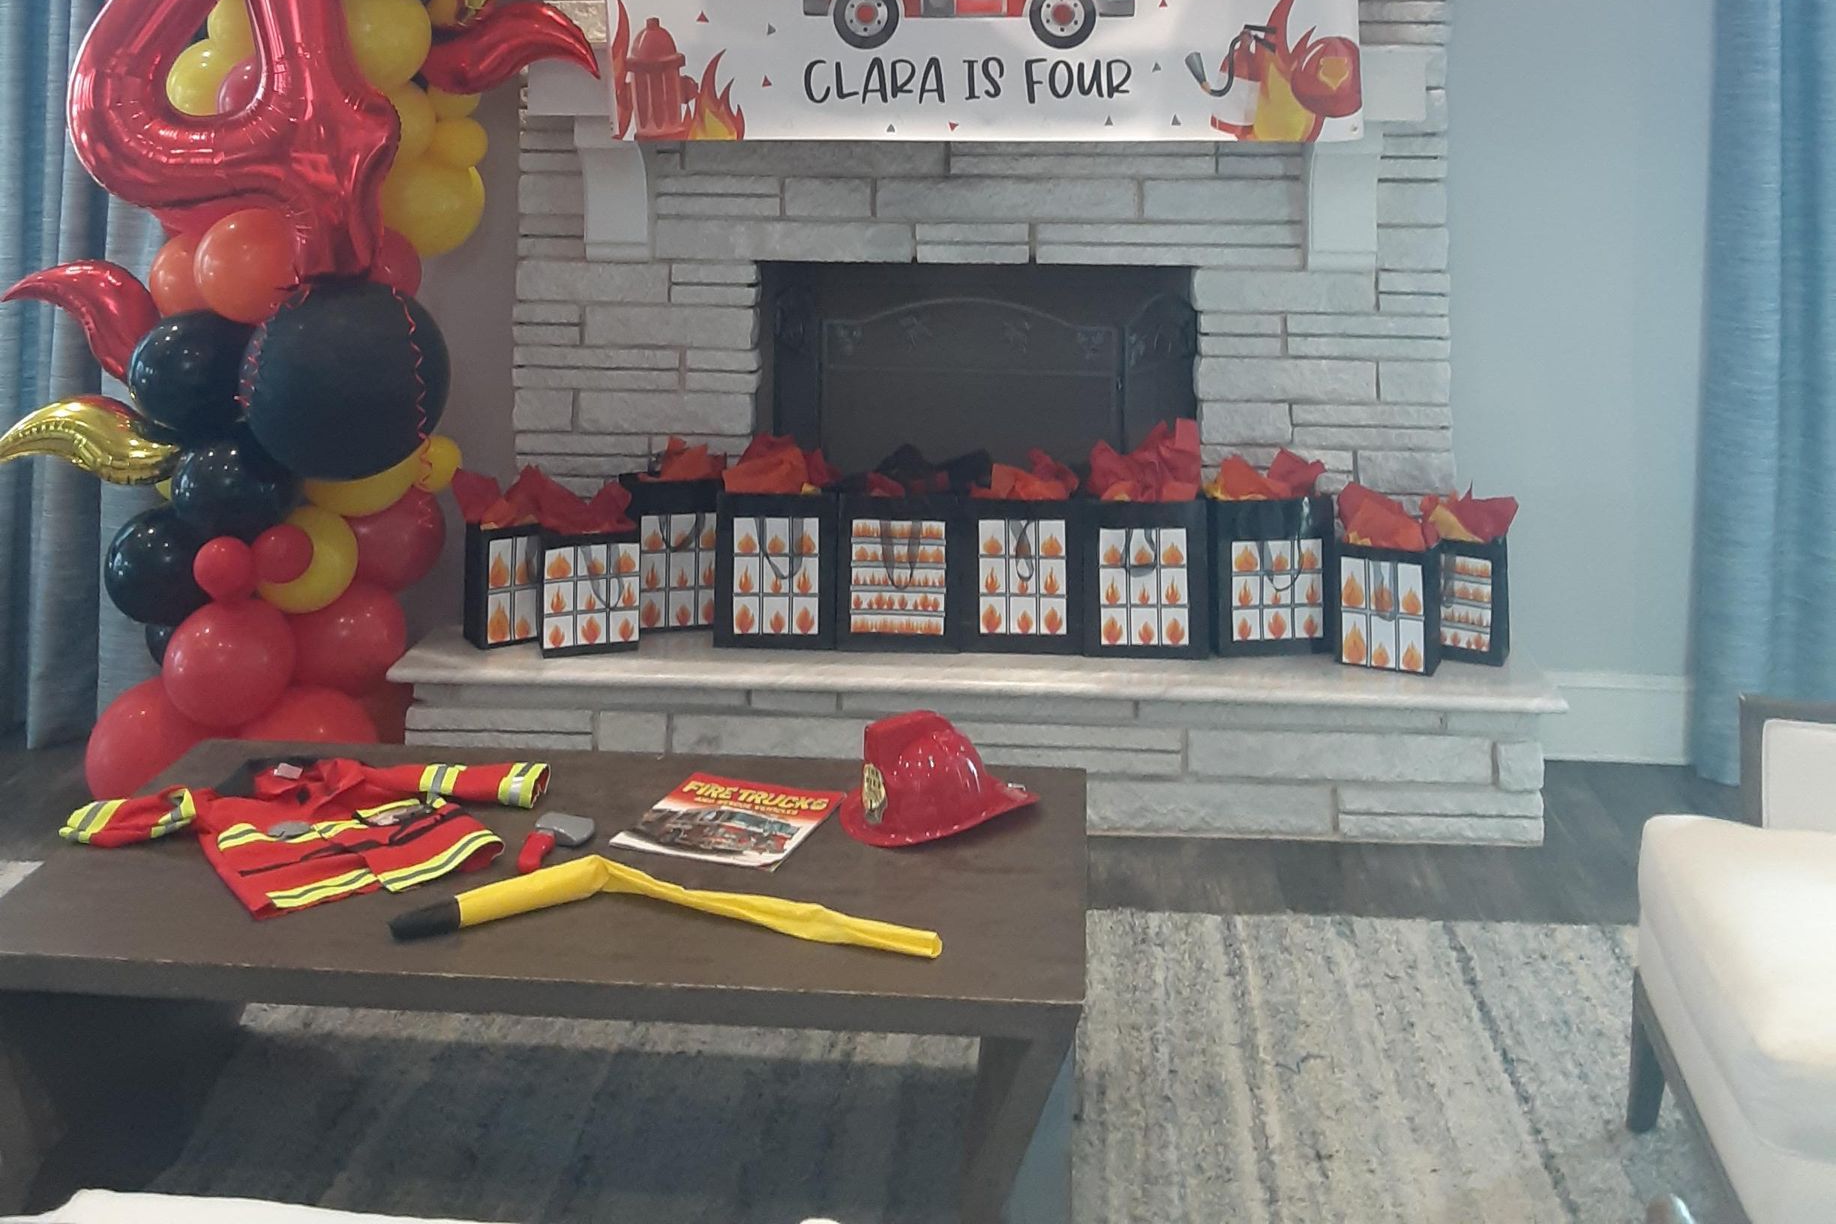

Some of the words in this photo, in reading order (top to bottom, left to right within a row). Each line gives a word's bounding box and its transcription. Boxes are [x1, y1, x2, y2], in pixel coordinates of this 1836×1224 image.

[803, 56, 946, 104] CLARA
[962, 56, 1005, 101] IS
[1024, 57, 1133, 104] FOUR
[683, 780, 738, 799] FIRE
[737, 789, 829, 810] TRUCKS
